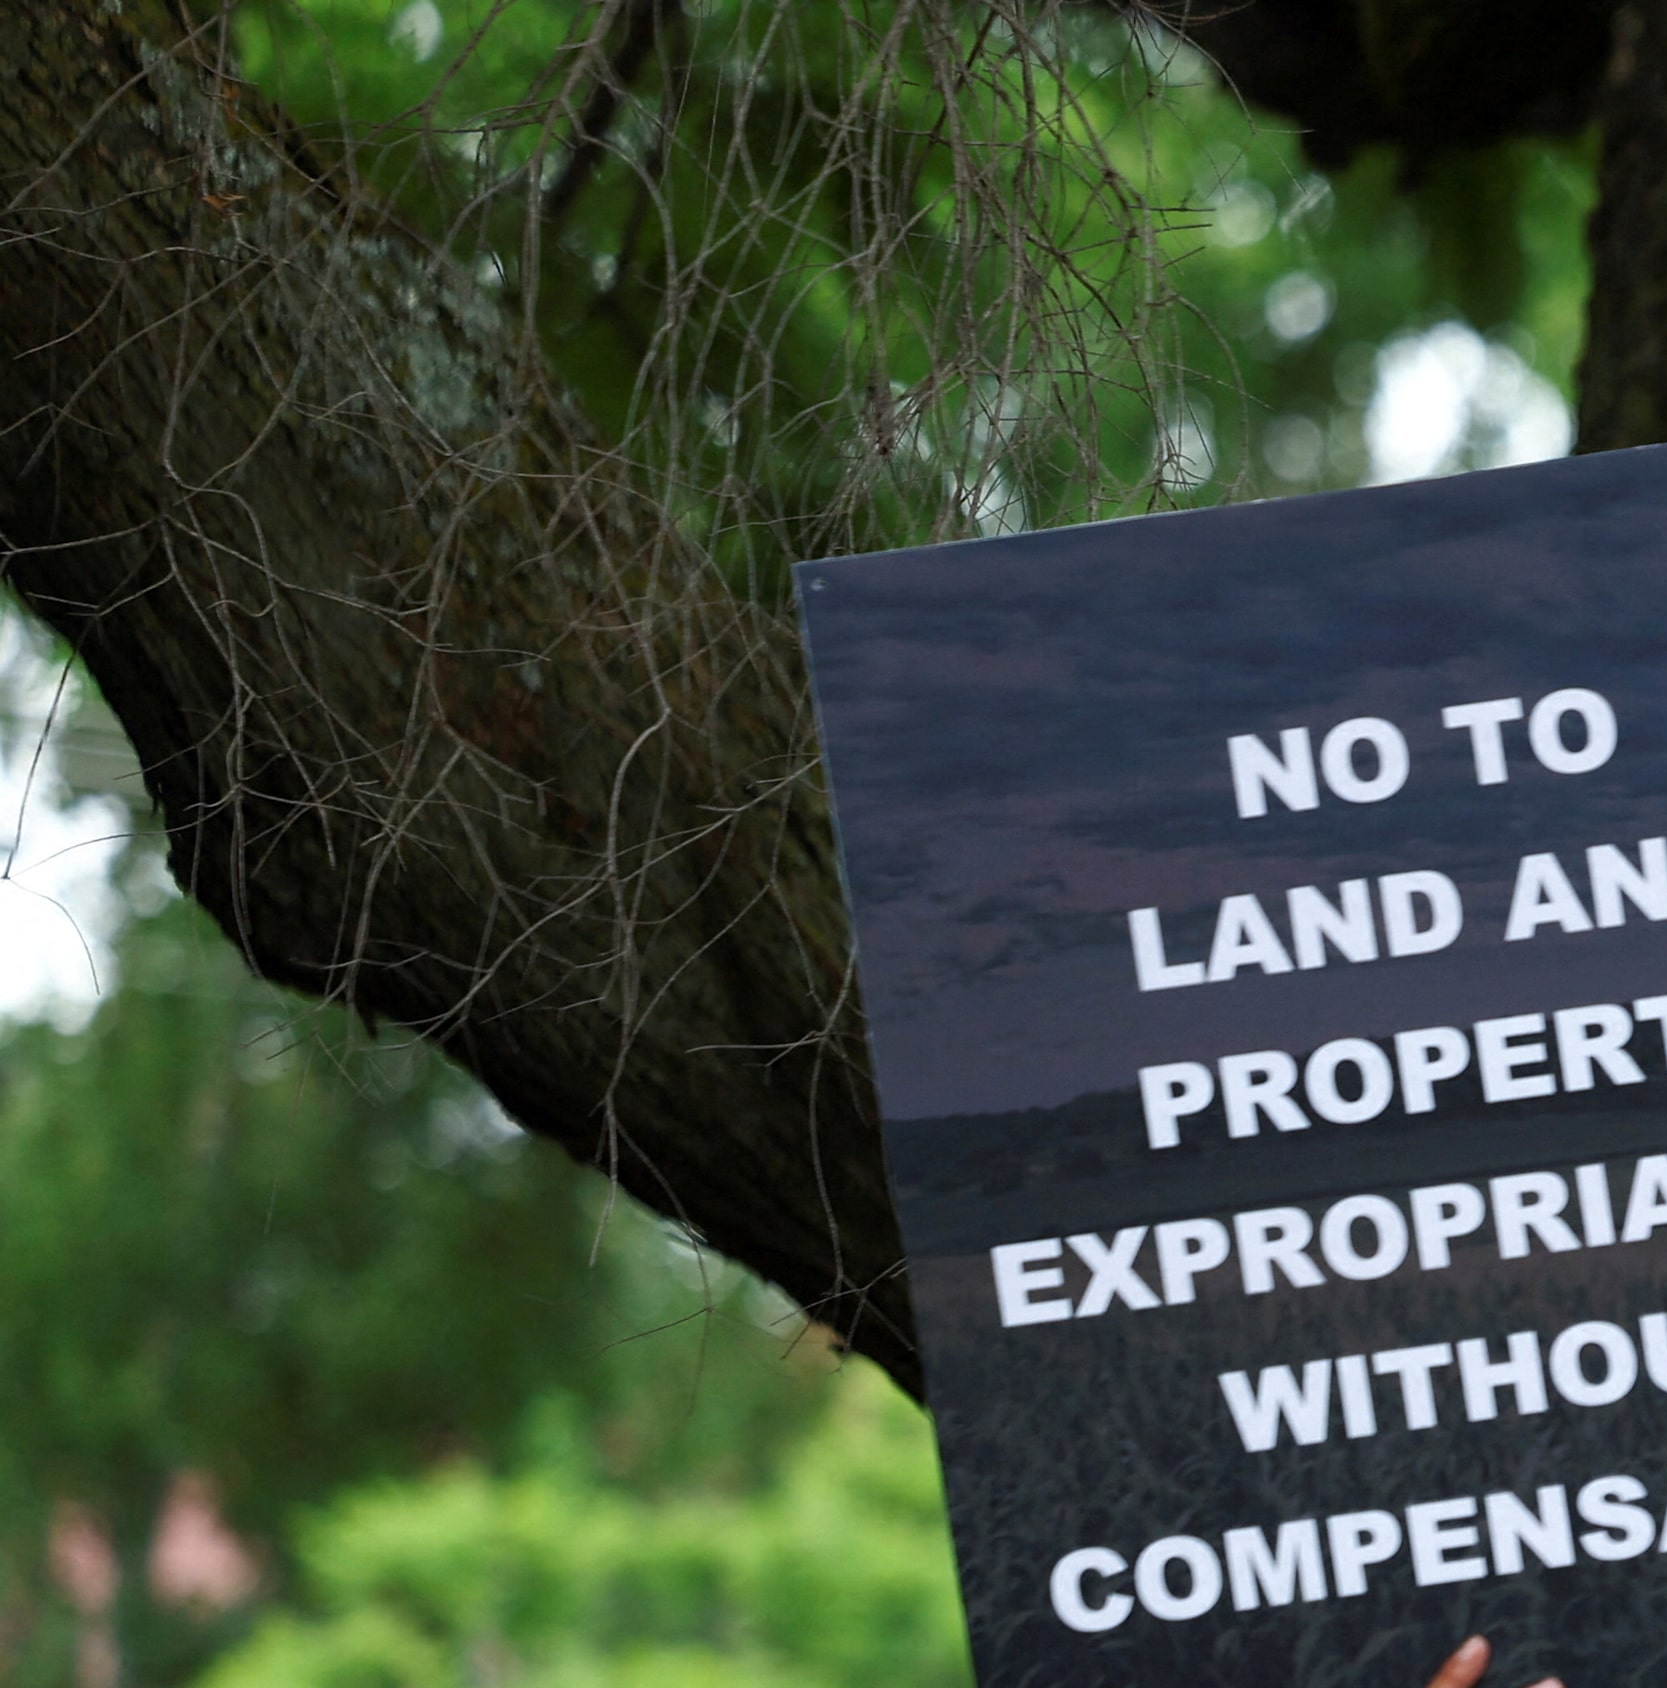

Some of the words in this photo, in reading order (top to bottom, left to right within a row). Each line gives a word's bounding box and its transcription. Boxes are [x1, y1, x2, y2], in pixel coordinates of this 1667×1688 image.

[1227, 716, 1410, 819] NO
[1441, 687, 1618, 786] TO
[1127, 869, 1464, 993] LAND
